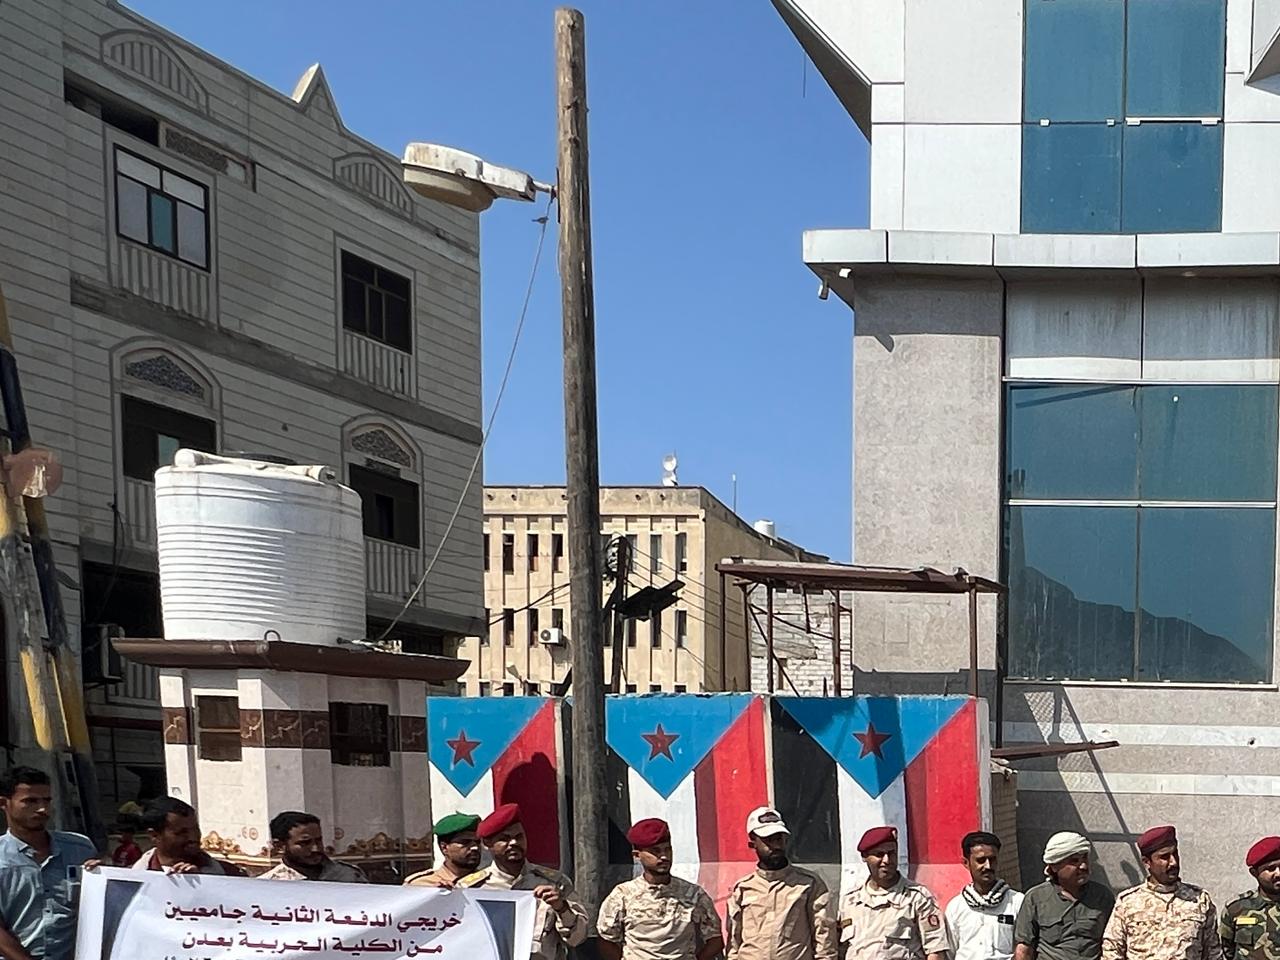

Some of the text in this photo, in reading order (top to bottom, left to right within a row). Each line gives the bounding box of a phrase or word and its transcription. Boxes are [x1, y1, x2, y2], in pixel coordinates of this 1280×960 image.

[164, 901, 461, 932] خريجي الدفعة الثانية جامعيين
[181, 932, 443, 957] من الكلية الحربية بعدن
